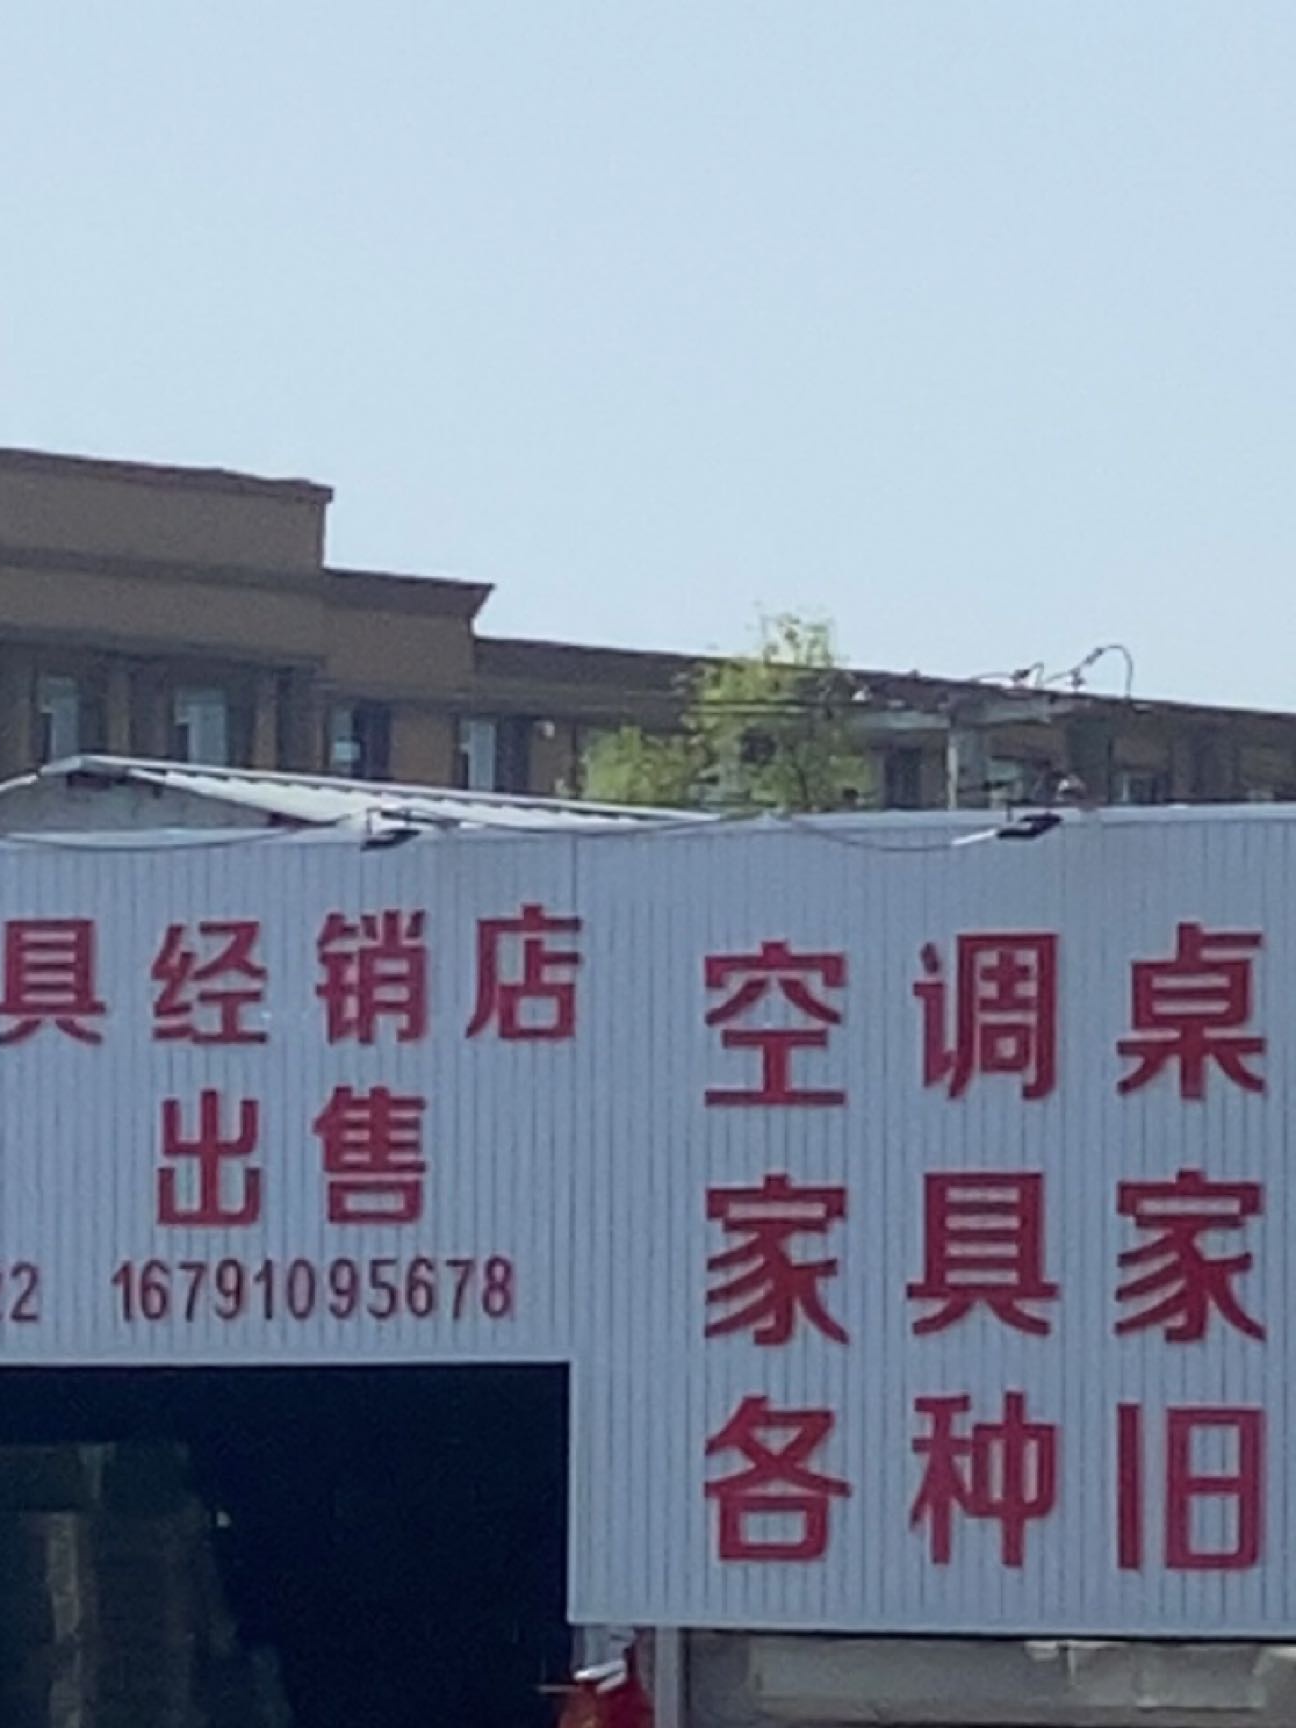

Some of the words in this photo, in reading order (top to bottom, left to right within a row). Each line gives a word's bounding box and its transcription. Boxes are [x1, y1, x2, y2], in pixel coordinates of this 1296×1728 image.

[705, 923, 1266, 1107] 空调桌
[157, 1087, 427, 1227] 出售
[111, 1257, 514, 1322] 16791095678
[705, 1170, 1267, 1346] 家具家
[705, 1391, 1264, 1572] 各种旧
